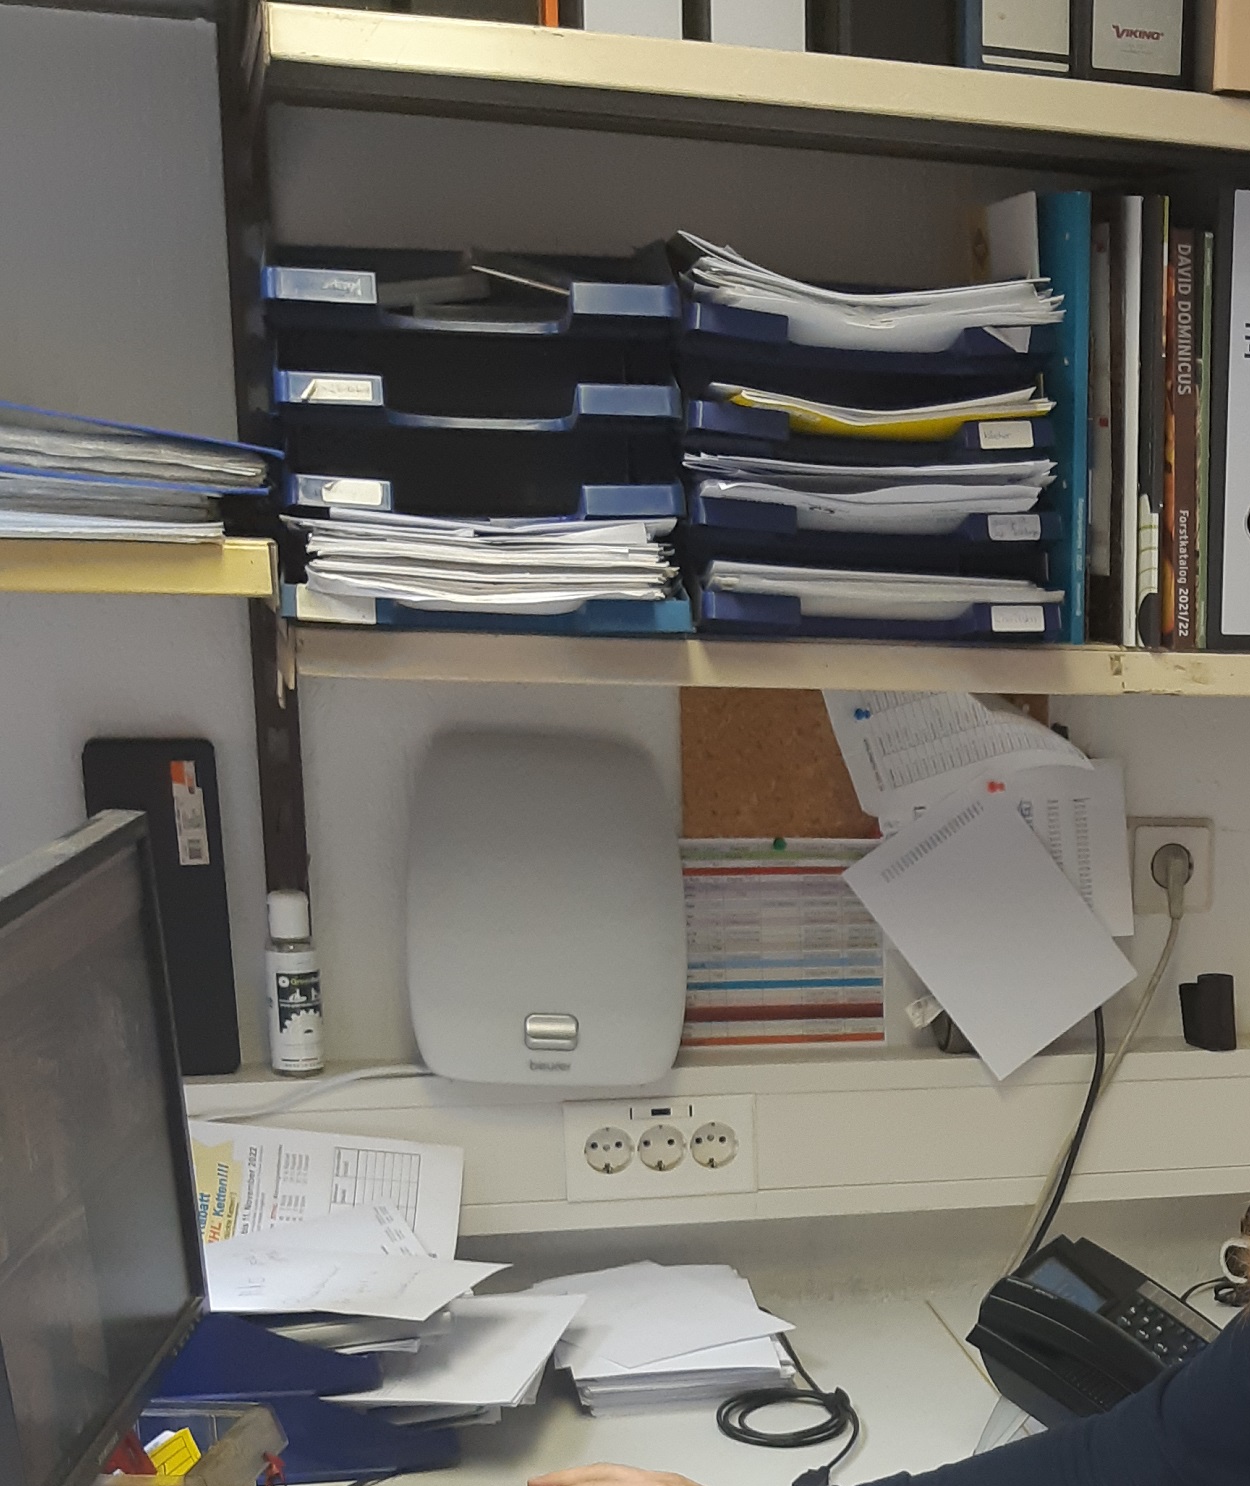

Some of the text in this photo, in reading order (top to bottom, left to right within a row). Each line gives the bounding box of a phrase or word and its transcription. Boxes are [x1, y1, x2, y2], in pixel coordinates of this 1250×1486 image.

[1177, 243, 1192, 396] DAVID DOMINICUS
[1178, 509, 1189, 638] Forstkatalog 2021/22
